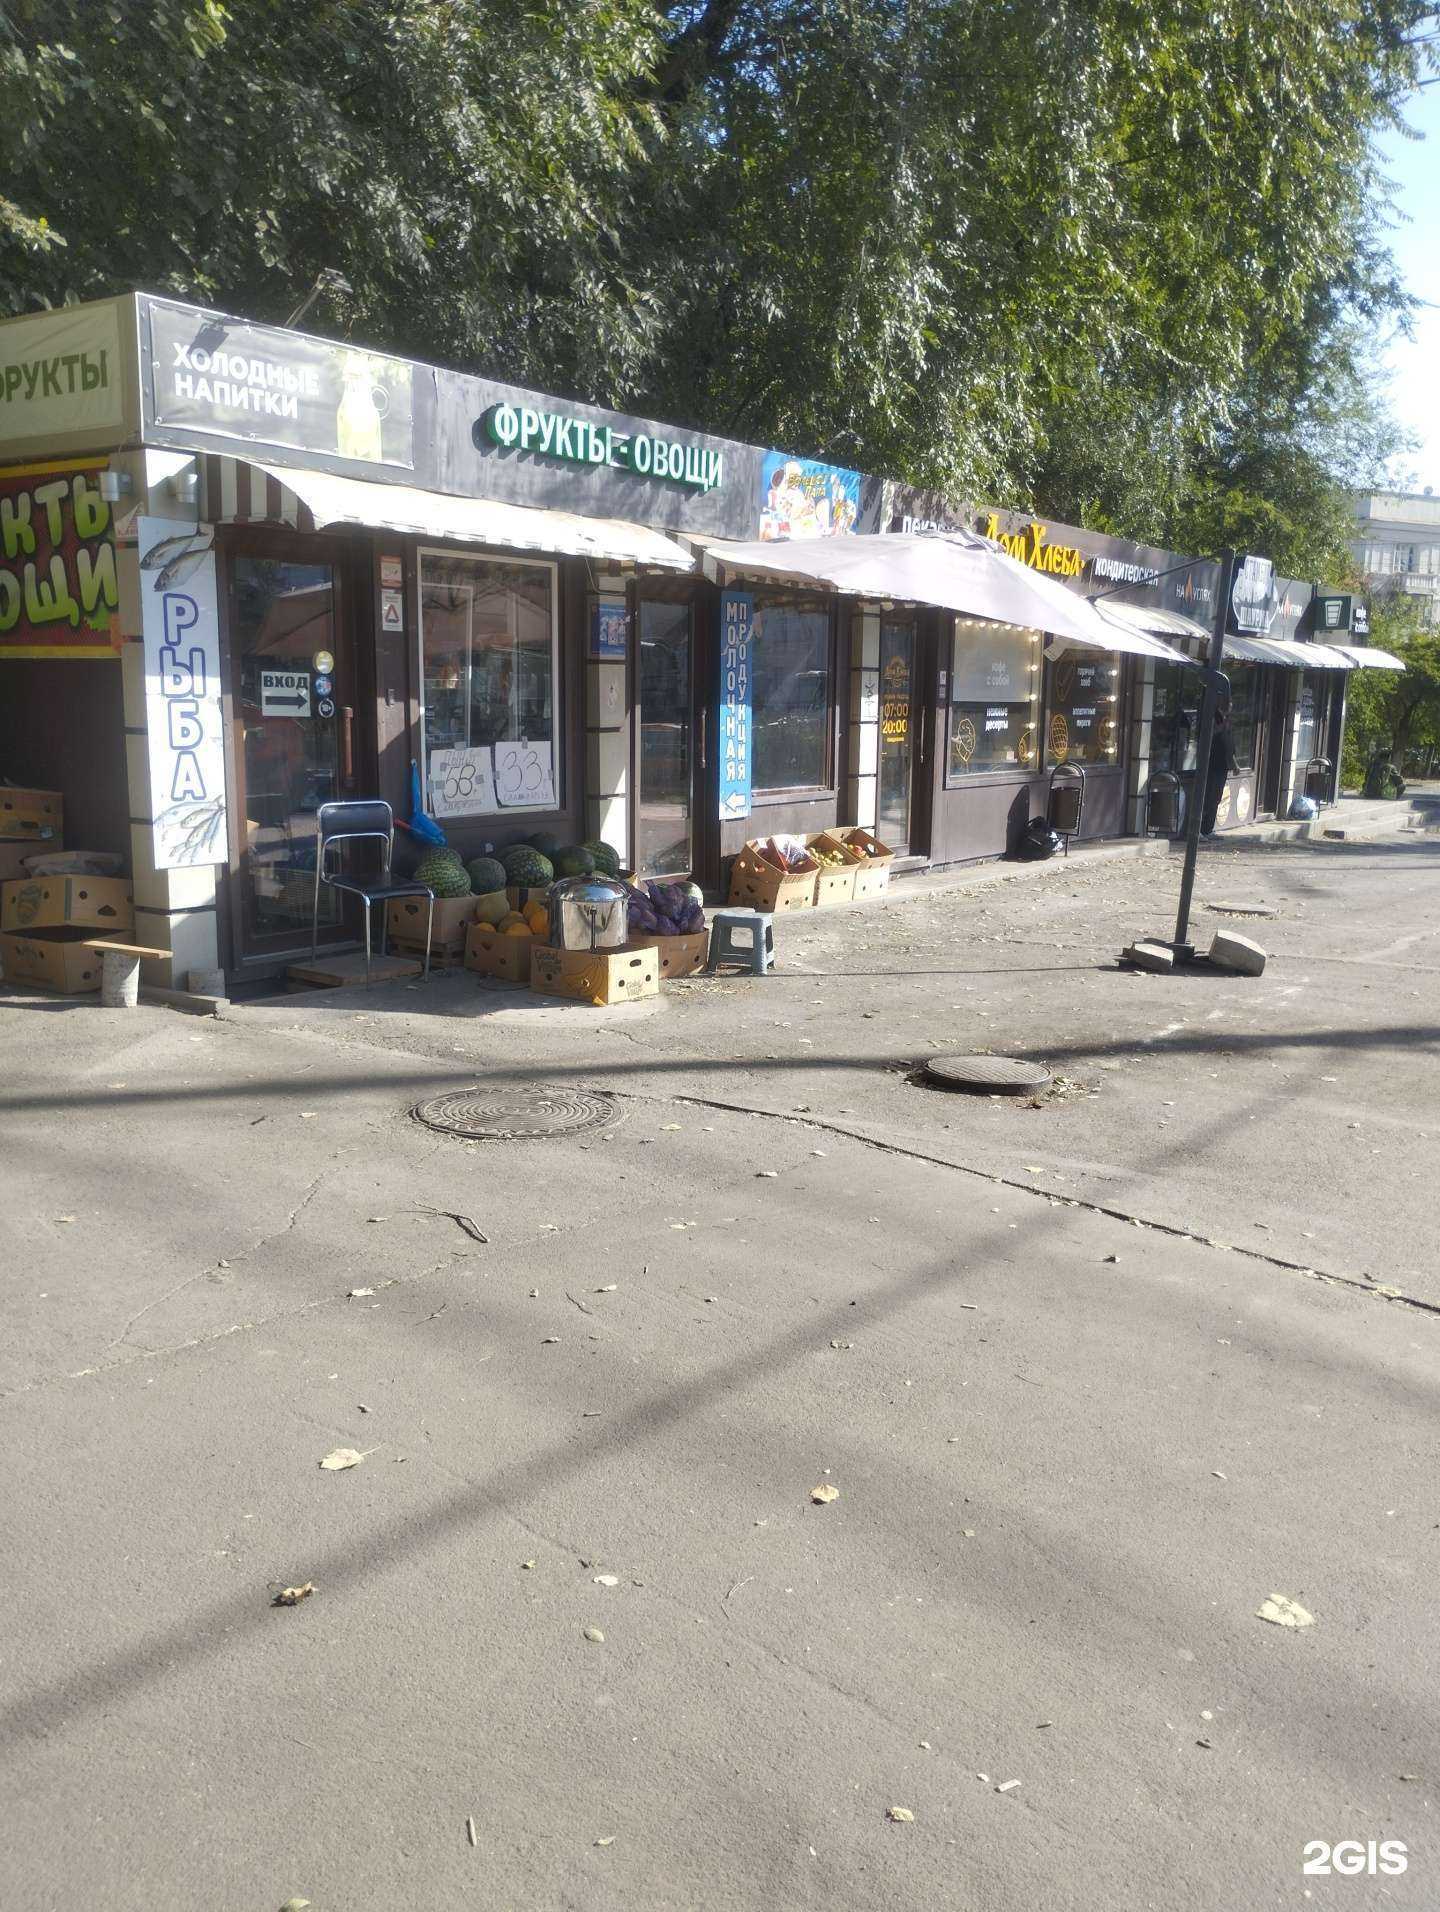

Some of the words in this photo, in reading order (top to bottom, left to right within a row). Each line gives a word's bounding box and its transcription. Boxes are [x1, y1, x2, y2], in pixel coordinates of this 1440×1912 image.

[0, 349, 108, 403] РУКТЫ
[173, 342, 320, 397] ХОЛОДНЫЕ
[174, 371, 298, 419] НАПИТКИ
[494, 403, 613, 465] ФРУКТЫ
[634, 434, 723, 492] ОВОЩИ
[159, 592, 207, 802] РЫБА
[263, 675, 309, 690] ВХОД
[725, 601, 737, 782] МОЛОЧНАЯ
[737, 600, 747, 782] ПРОДУКЦИЯ
[882, 719, 908, 734] 20:00
[884, 703, 909, 717] 07:00
[501, 750, 543, 793] 33
